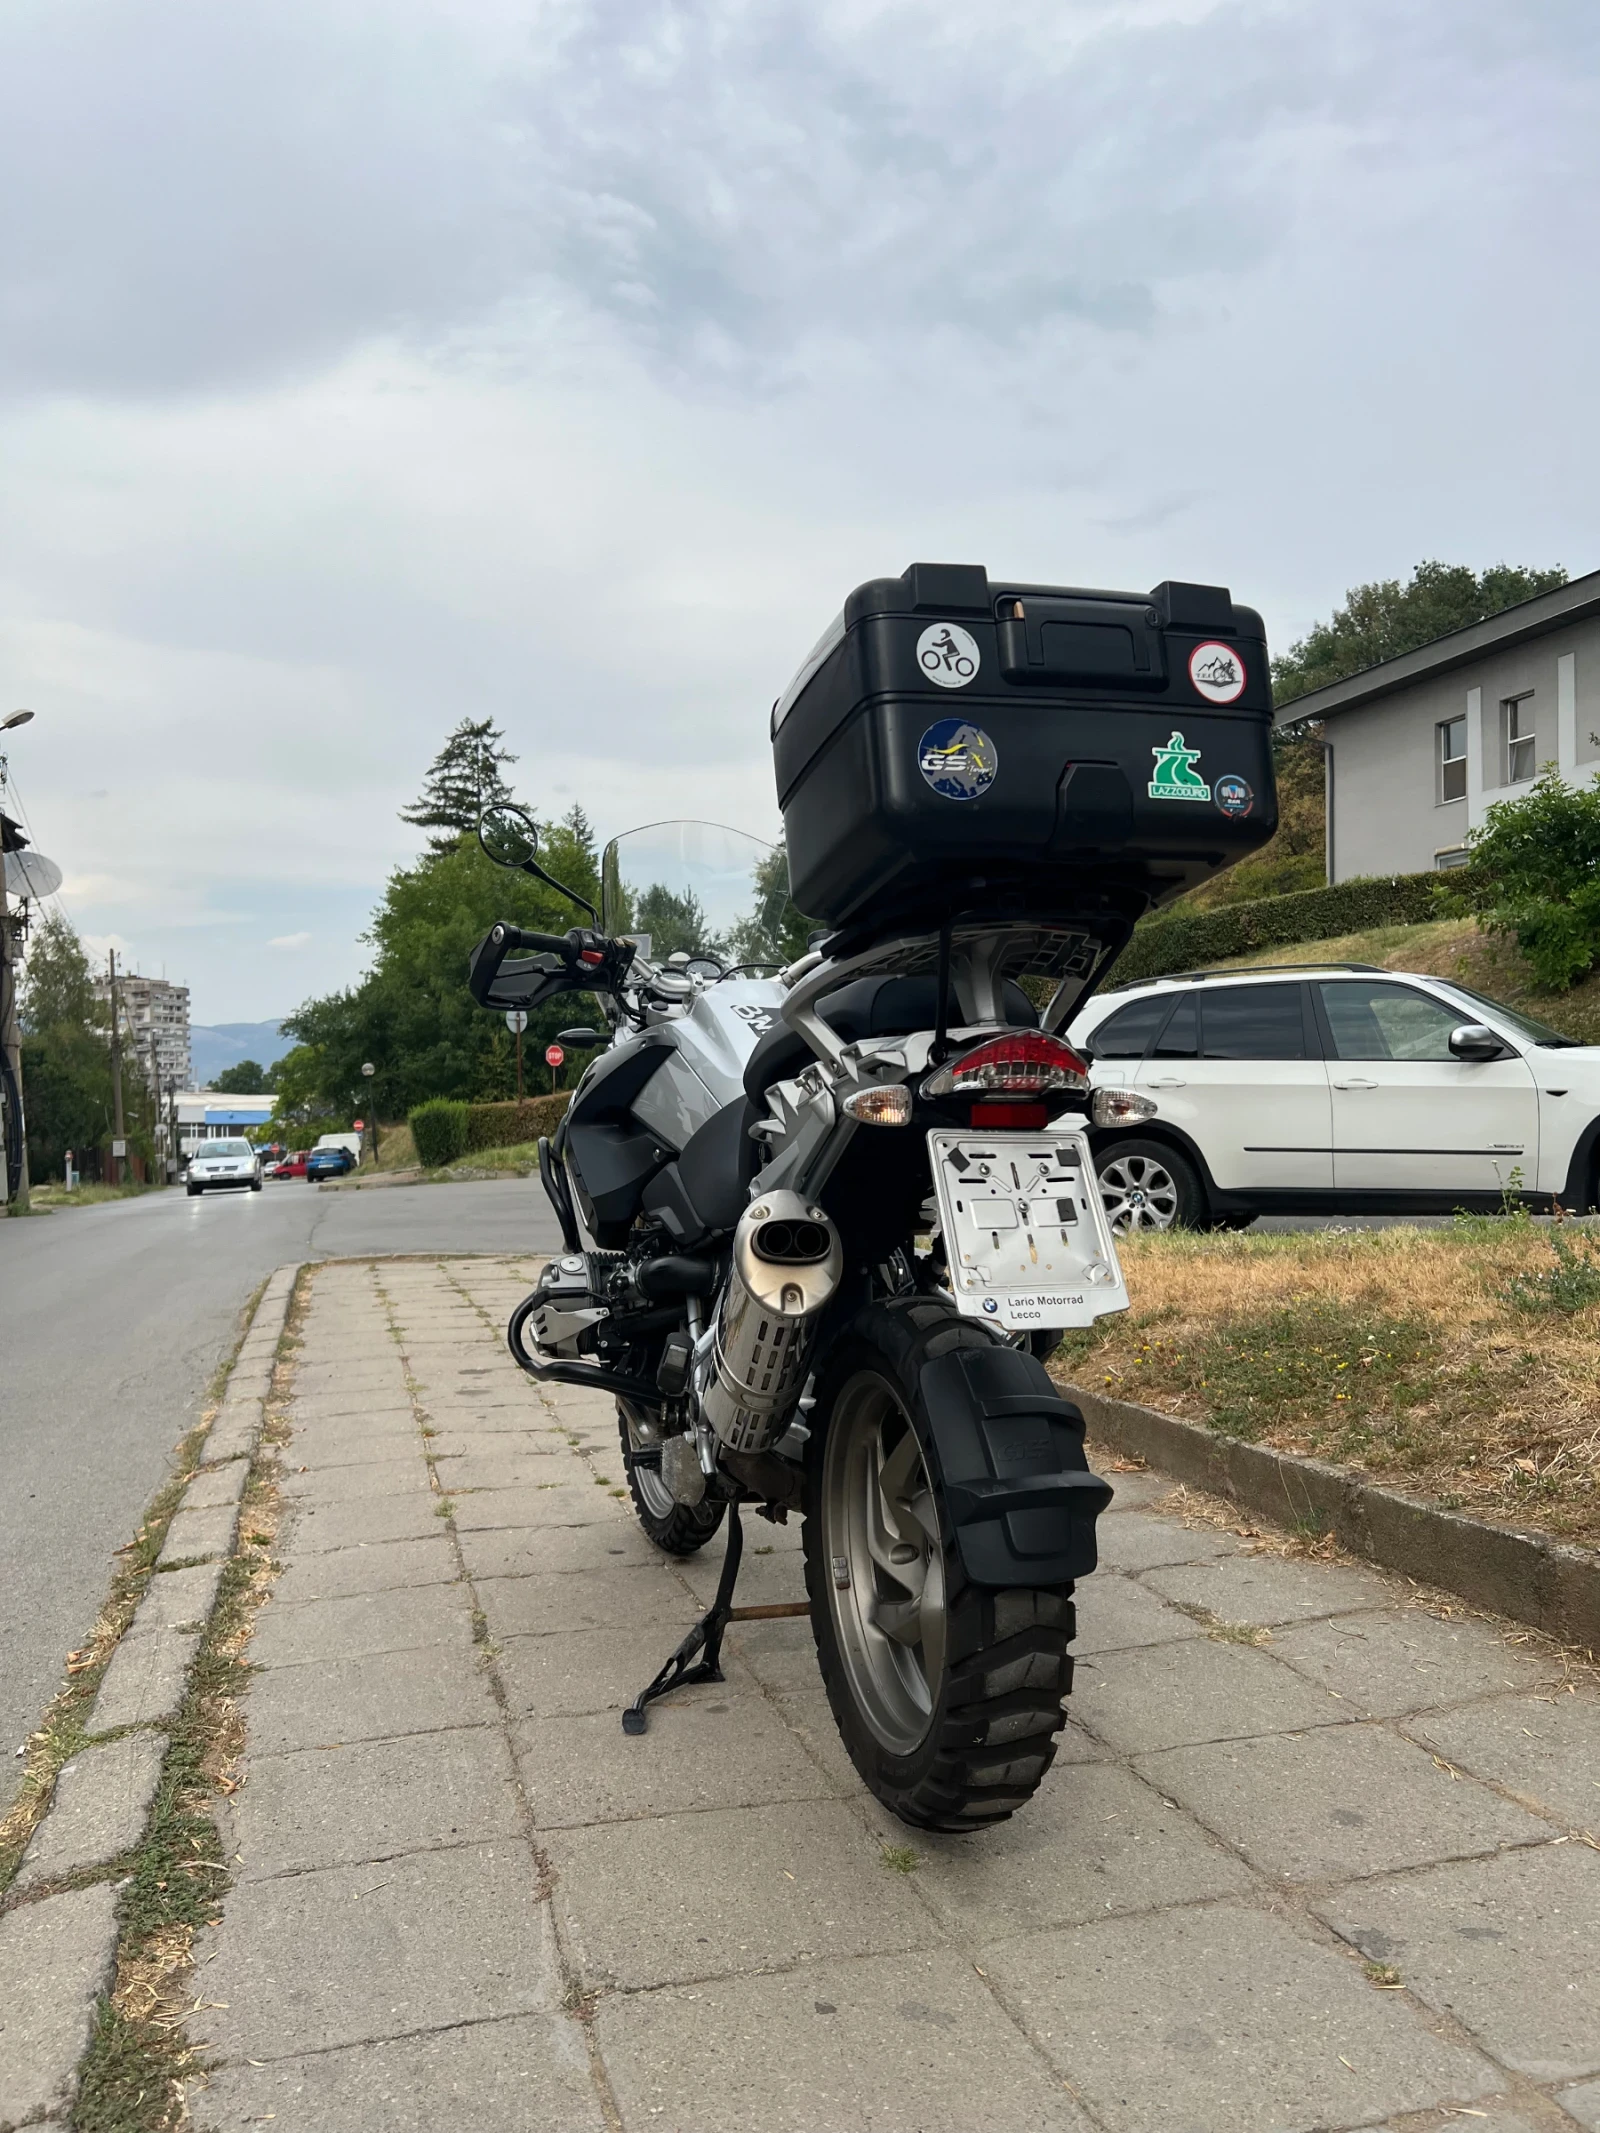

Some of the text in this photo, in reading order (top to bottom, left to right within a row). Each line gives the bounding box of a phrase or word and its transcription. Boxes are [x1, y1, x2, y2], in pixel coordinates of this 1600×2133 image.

[921, 754, 968, 771] GS
[1152, 786, 1207, 799] LAZZODURO
[730, 1004, 774, 1035] BM
[548, 1052, 562, 1060] STOP
[1008, 1294, 1084, 1307] Lario Motorrad
[1010, 1310, 1041, 1320] Lecco
